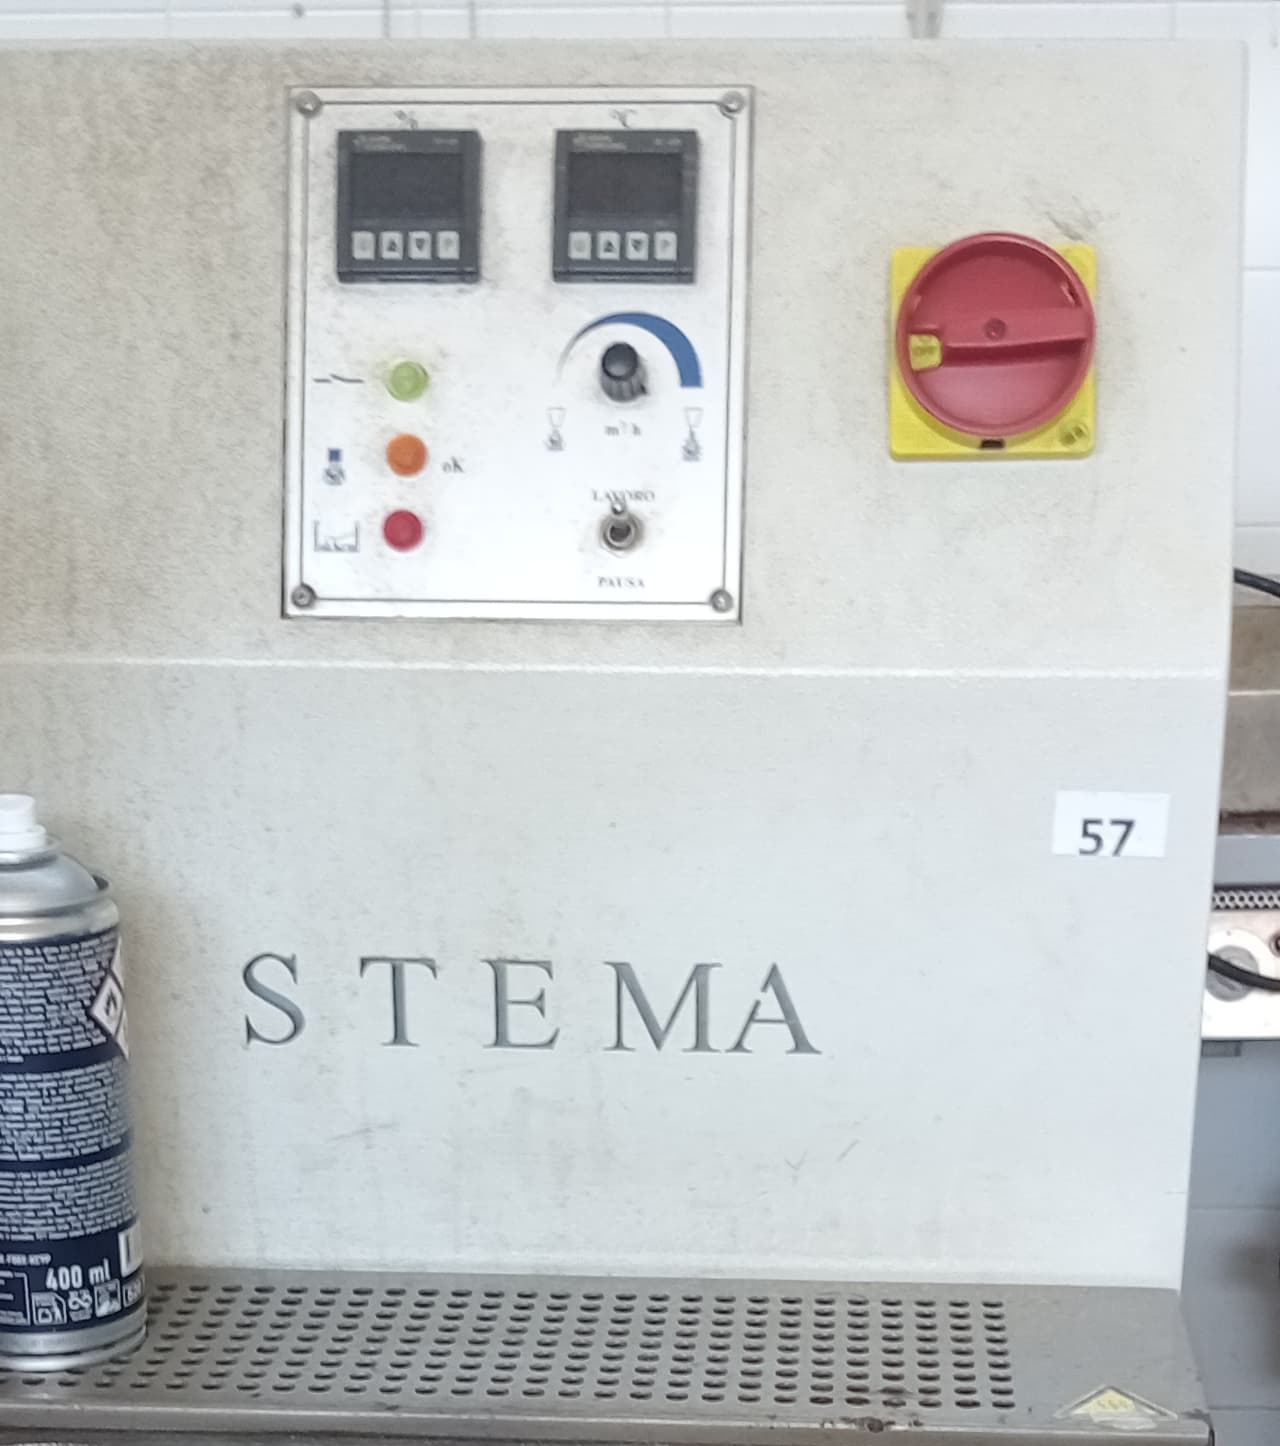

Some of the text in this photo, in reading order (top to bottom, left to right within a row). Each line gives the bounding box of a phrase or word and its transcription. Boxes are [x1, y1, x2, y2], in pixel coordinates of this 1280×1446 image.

[1077, 818, 1136, 857] 57
[241, 952, 823, 1055] STEMA
[45, 1258, 111, 1291] 400 ml
